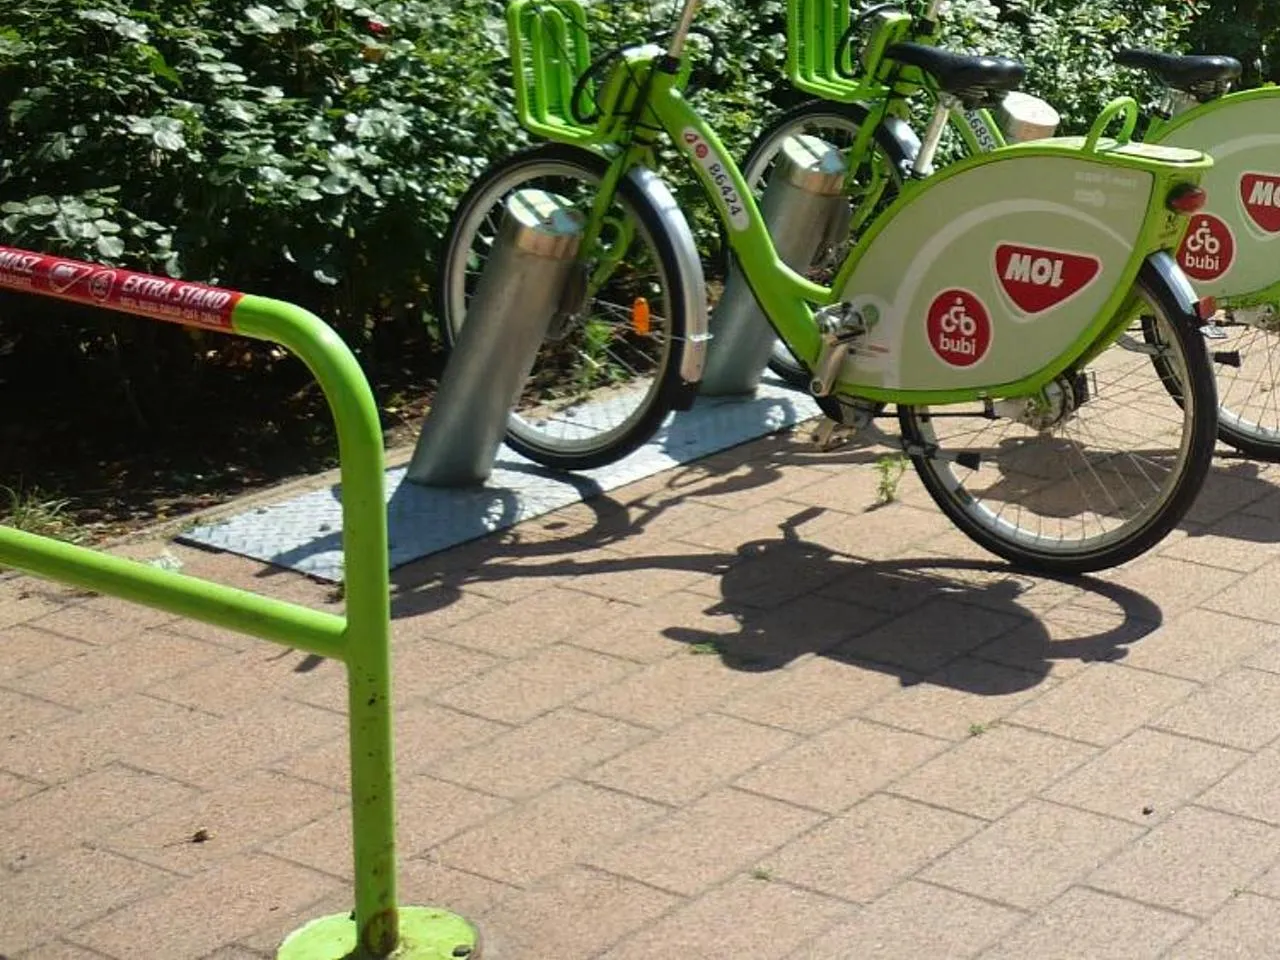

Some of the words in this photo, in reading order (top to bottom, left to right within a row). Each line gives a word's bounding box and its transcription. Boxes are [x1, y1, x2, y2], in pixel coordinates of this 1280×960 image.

[709, 162, 742, 216] 86424
[1004, 253, 1064, 288] MOL
[1185, 253, 1220, 271] bubi
[120, 275, 175, 300] EXTRA
[173, 285, 232, 309] STAND
[940, 332, 976, 356] bubi
